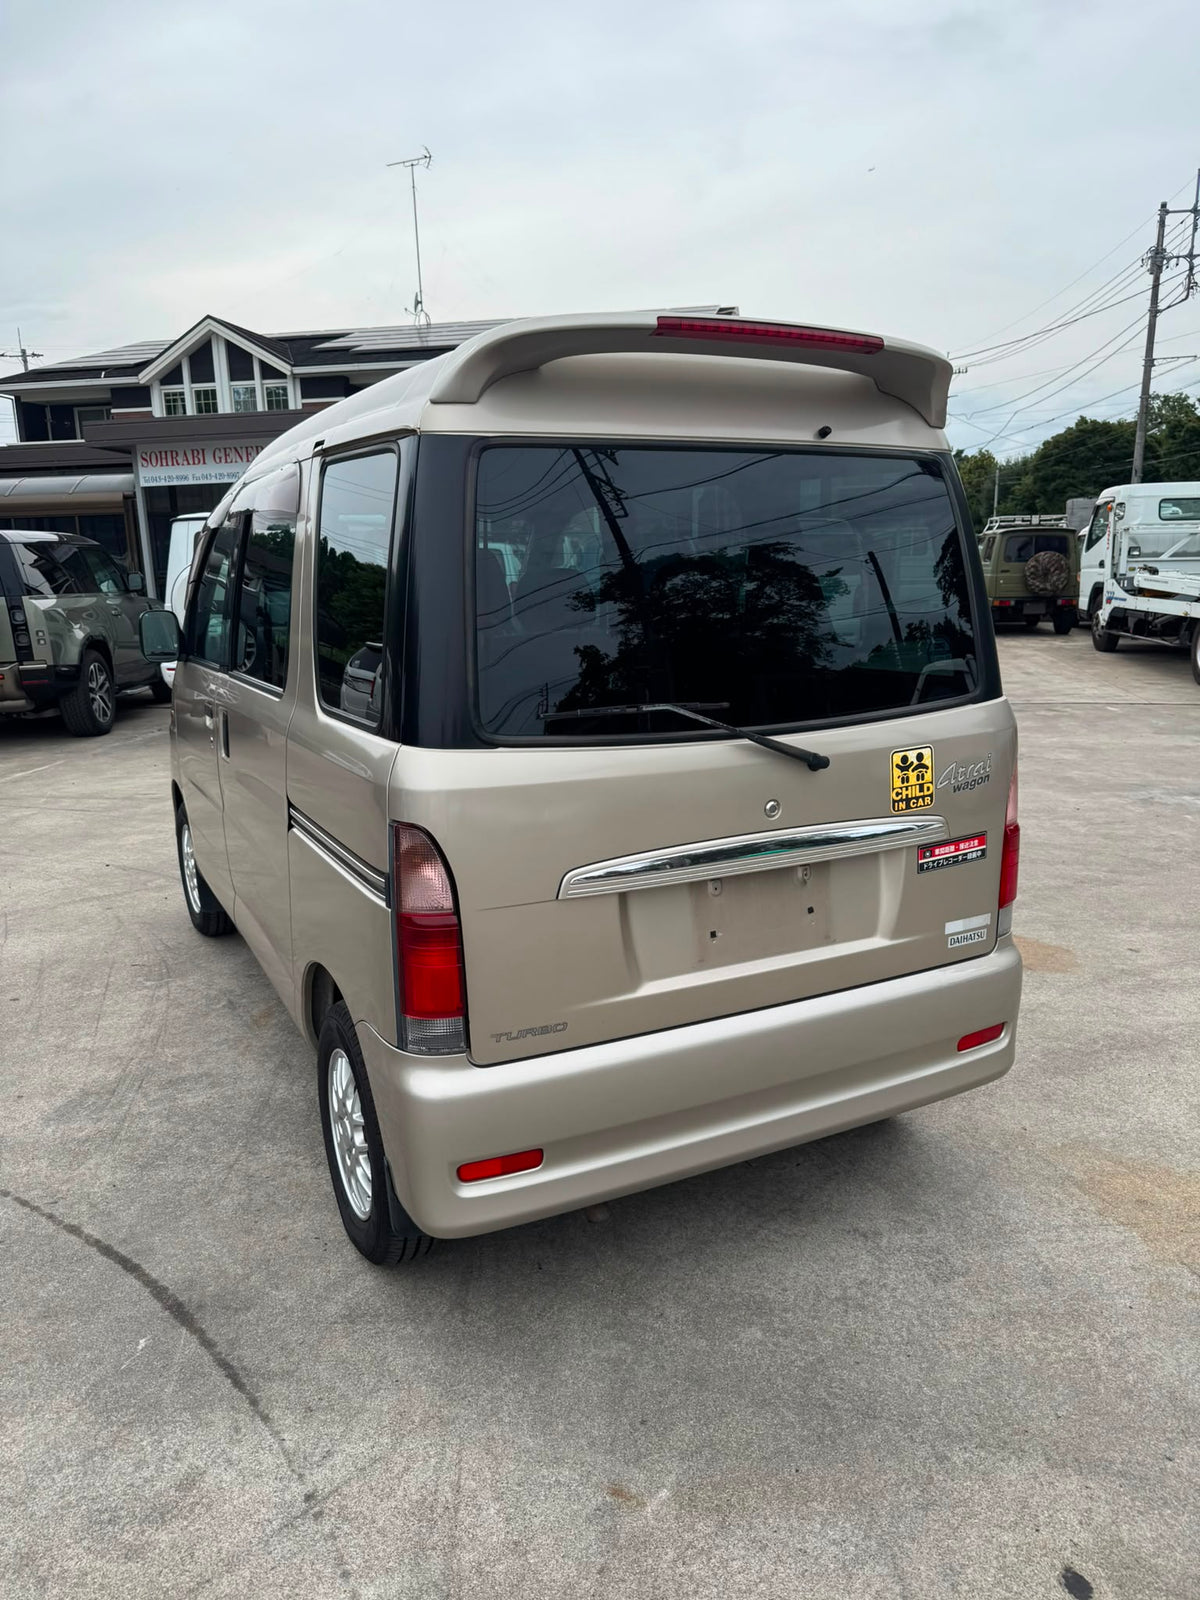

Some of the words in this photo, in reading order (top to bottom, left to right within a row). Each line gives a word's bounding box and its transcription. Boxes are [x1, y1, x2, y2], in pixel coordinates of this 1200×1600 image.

[140, 448, 207, 468] SOHRABI
[936, 752, 992, 789] Atrai
[892, 783, 934, 801] CHILD
[952, 773, 990, 793] wagon
[894, 801, 906, 811] IN
[910, 796, 931, 808] CAR
[949, 930, 985, 946] DAIHATSU
[490, 1022, 568, 1043] TURBO
